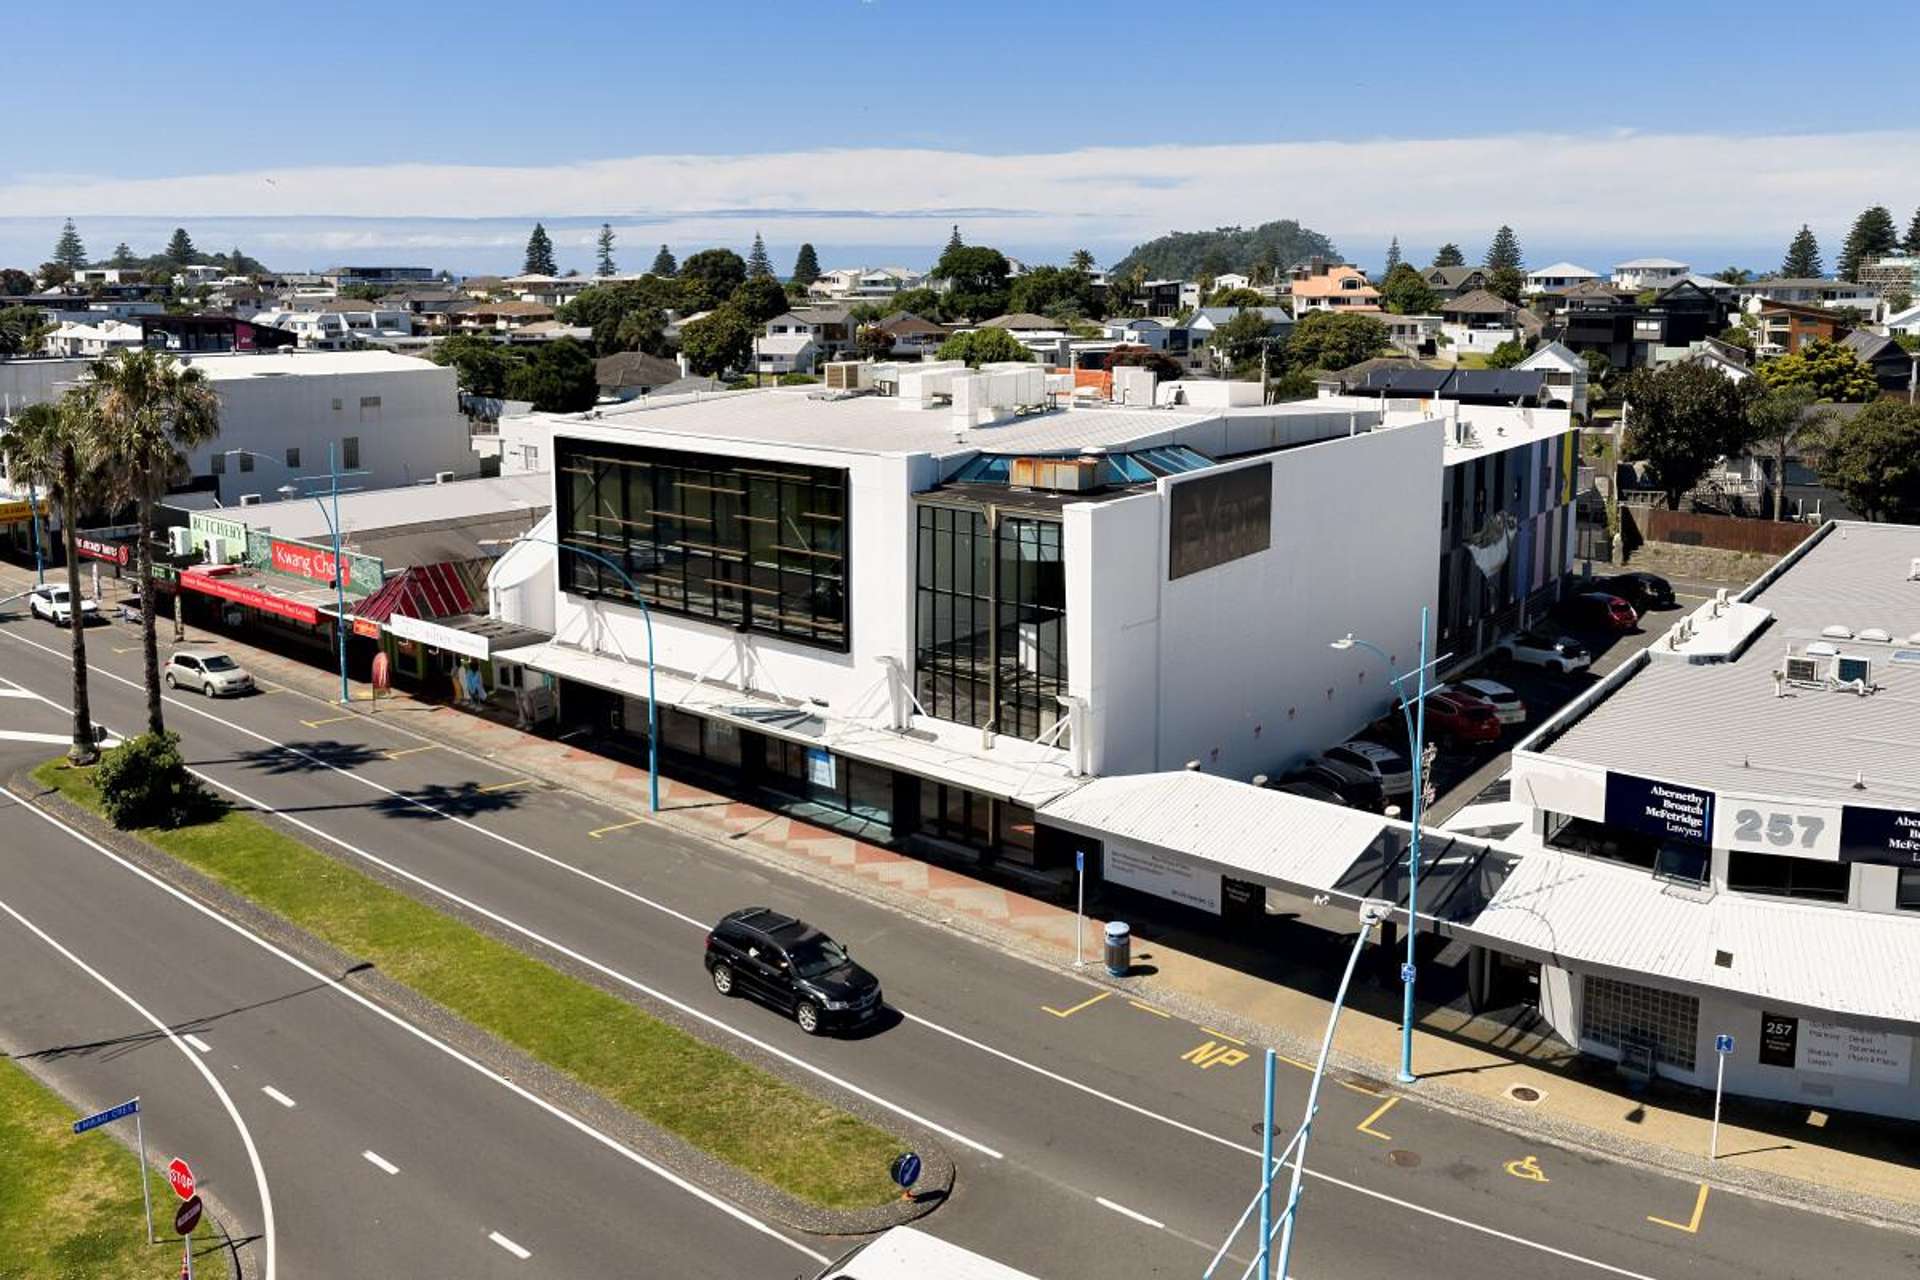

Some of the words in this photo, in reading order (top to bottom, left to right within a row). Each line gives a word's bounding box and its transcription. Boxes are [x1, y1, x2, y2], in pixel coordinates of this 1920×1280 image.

[276, 546, 311, 576] Kwang
[1650, 785, 1704, 807] Abernethy
[1663, 799, 1703, 815] Broatch
[1645, 806, 1703, 827] McFetridge
[1666, 822, 1702, 837] Lawyers
[1734, 808, 1825, 849] 257
[1766, 1022, 1792, 1036] 257
[1180, 1041, 1249, 1069] NP
[169, 1168, 193, 1190] STOP
